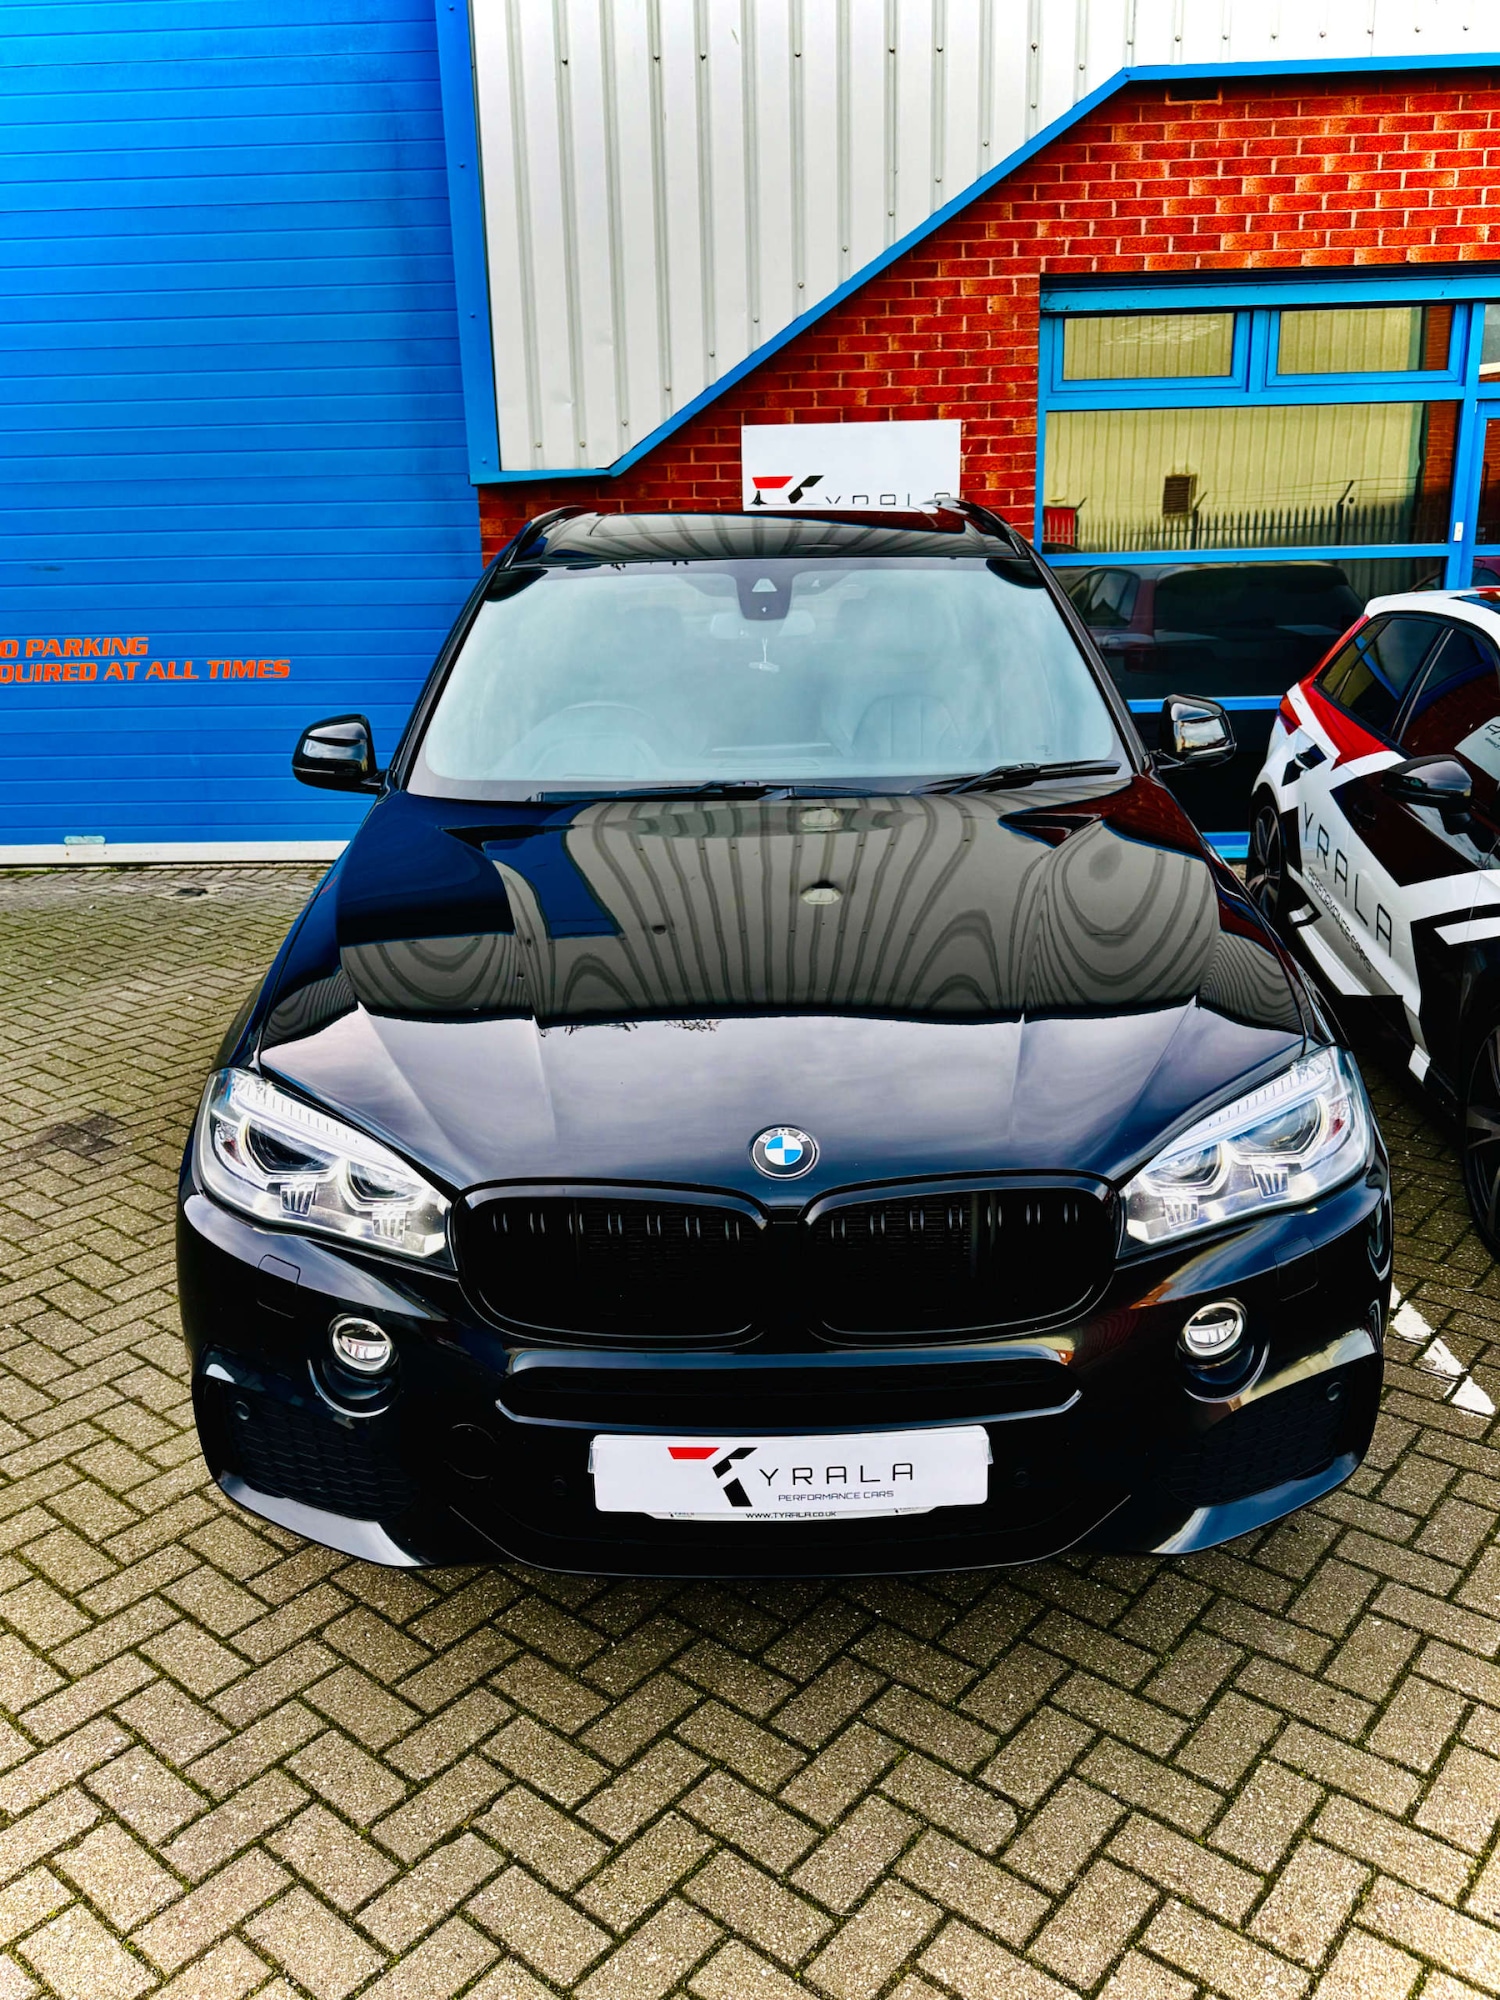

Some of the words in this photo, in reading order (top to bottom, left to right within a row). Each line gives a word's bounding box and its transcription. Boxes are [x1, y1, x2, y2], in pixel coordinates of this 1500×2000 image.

[0, 639, 19, 658] O
[25, 637, 149, 658] PARKING
[104, 662, 140, 680] AT
[145, 661, 199, 680] ALL
[207, 660, 291, 678] TIMES
[778, 1492, 861, 1502] PERFORMANCE
[863, 1490, 895, 1499] CARS
